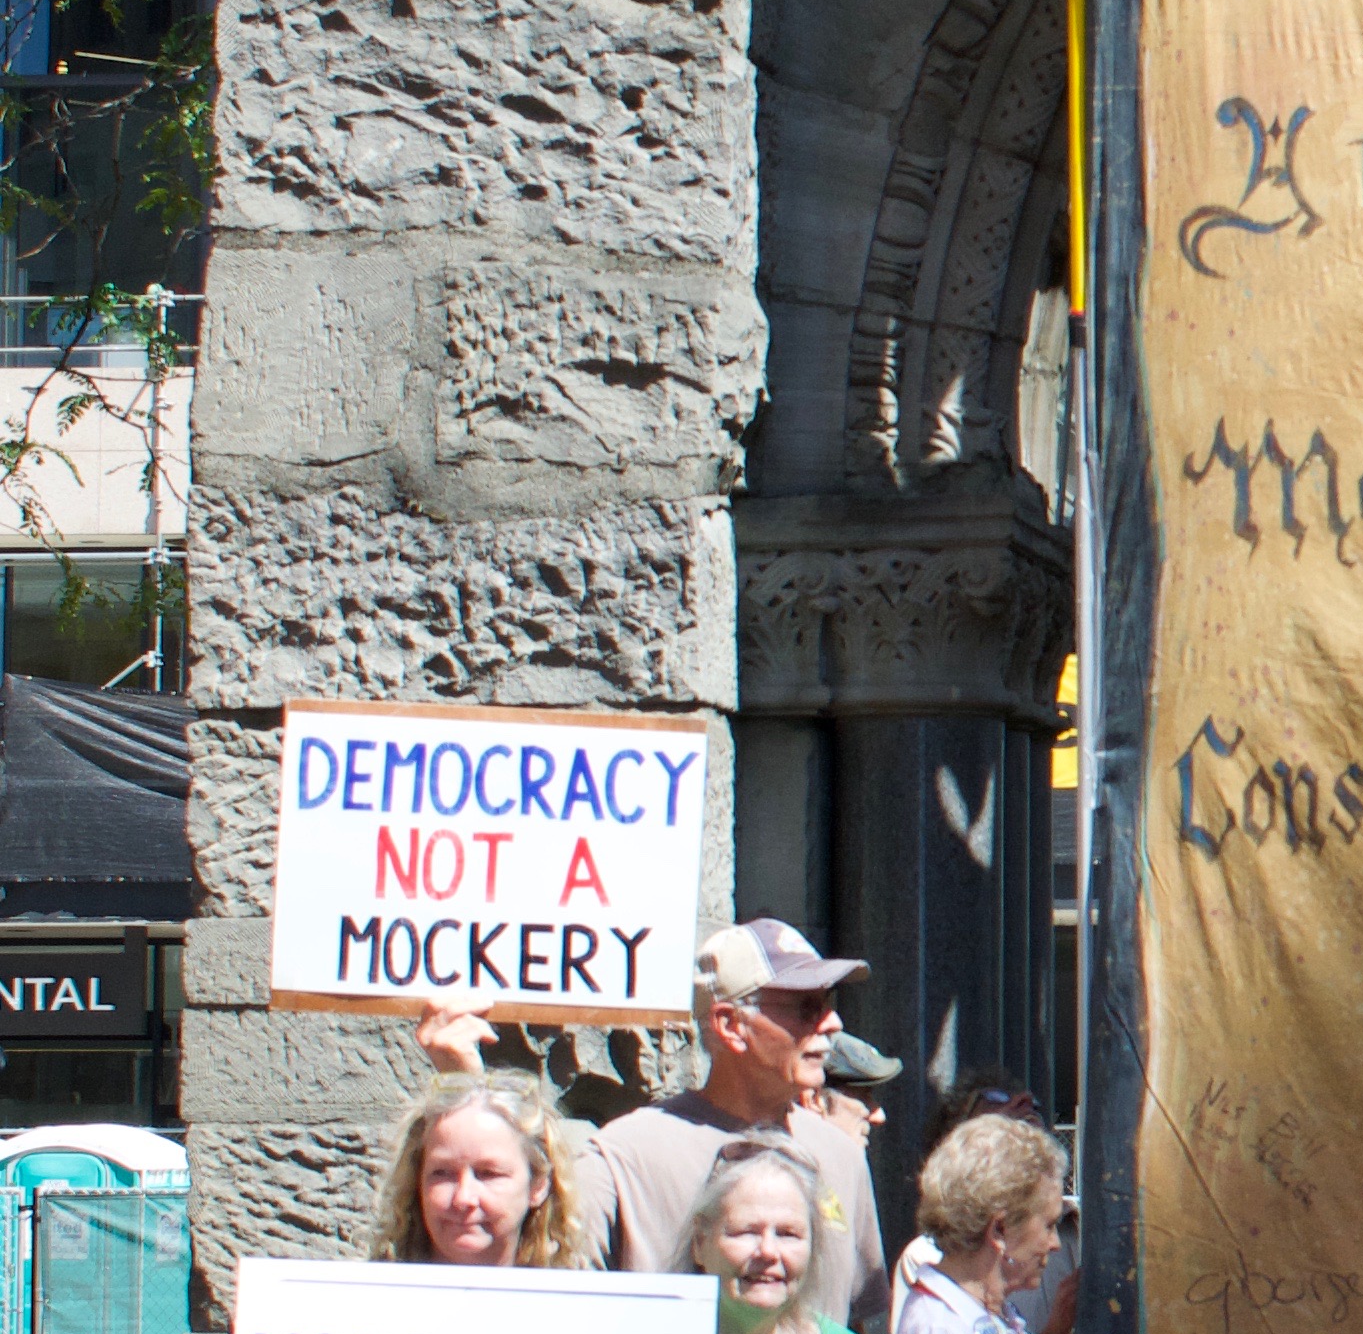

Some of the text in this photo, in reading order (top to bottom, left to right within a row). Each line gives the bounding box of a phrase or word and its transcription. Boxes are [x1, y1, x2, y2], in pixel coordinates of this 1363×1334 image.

[1179, 96, 1326, 279] A
[297, 737, 699, 826] DEMOCRACY
[375, 825, 611, 908] NOT A
[337, 916, 653, 999] MOCKERY
